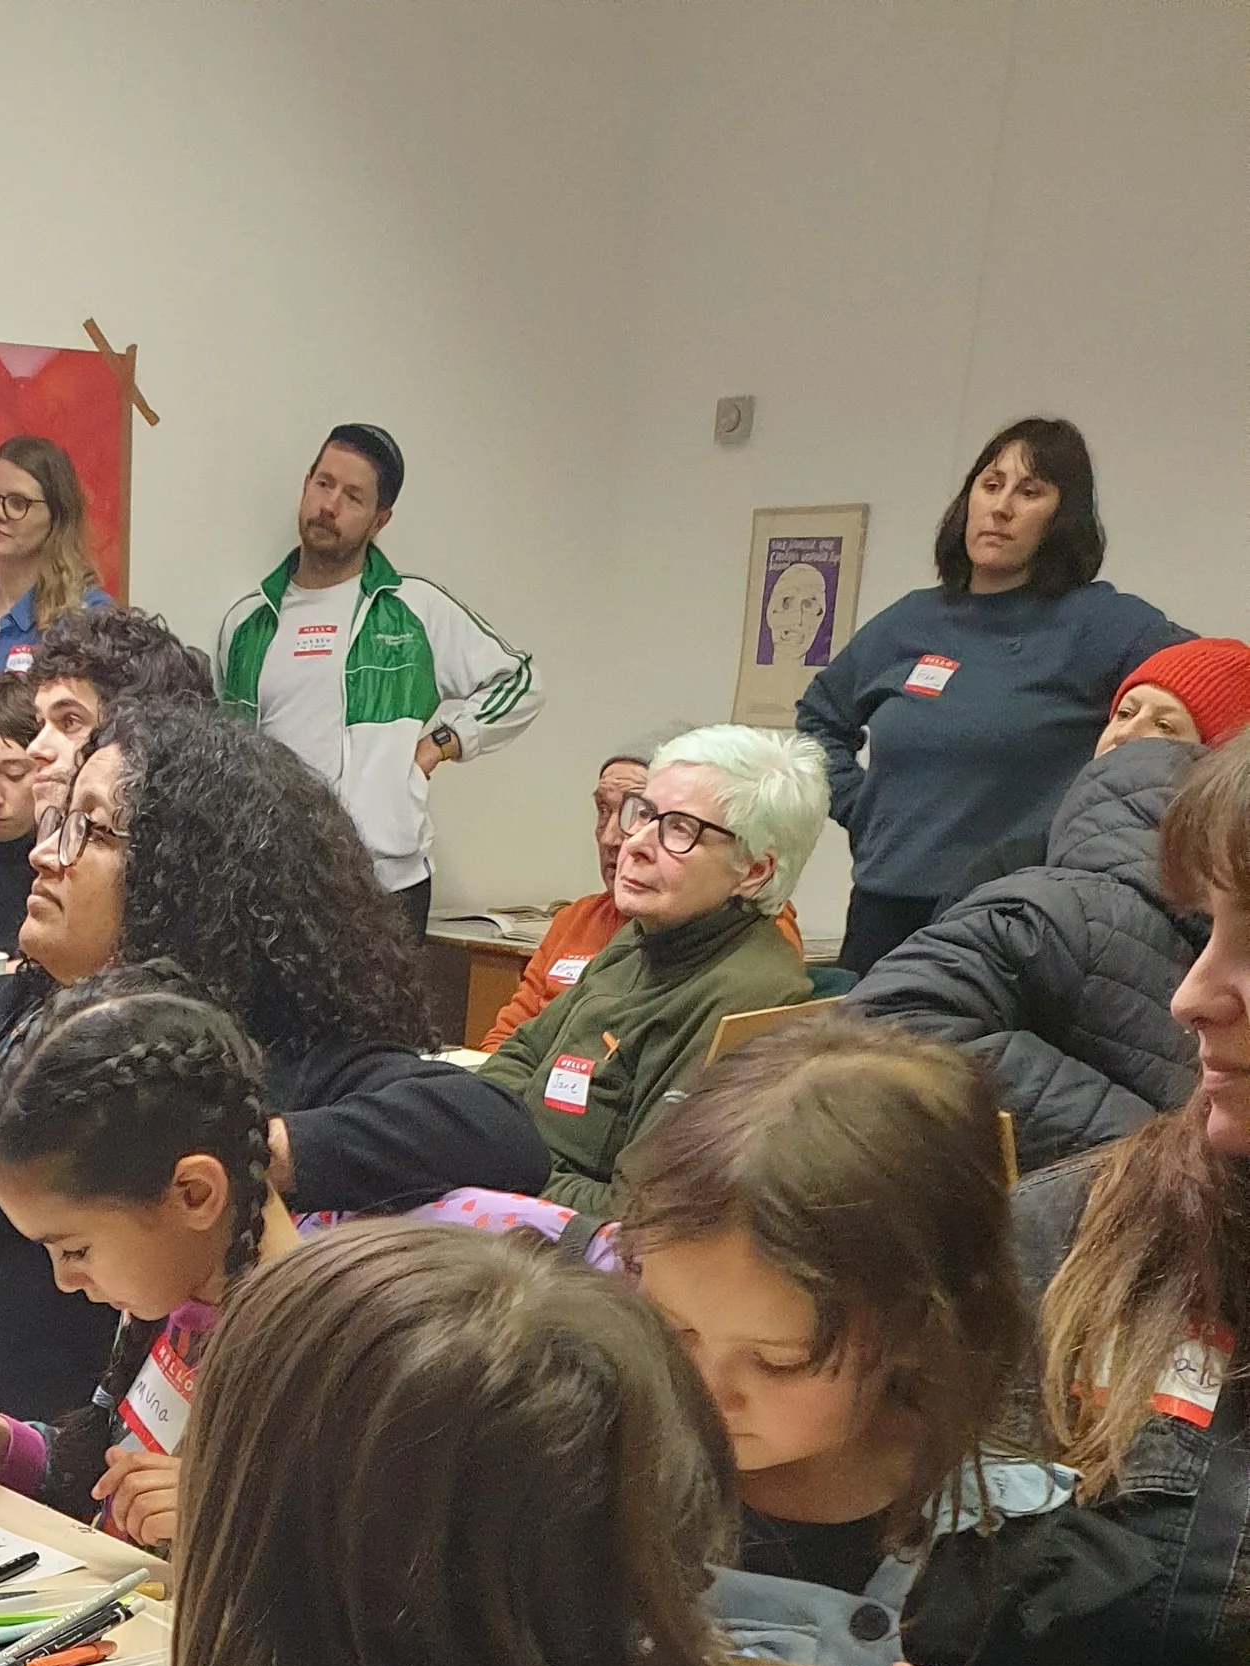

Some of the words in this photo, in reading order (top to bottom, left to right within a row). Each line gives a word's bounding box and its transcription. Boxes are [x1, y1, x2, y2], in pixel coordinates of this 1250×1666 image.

[560, 1059, 588, 1071] HELLO
[551, 1073, 578, 1094] Jane
[158, 1345, 194, 1392] HELLO
